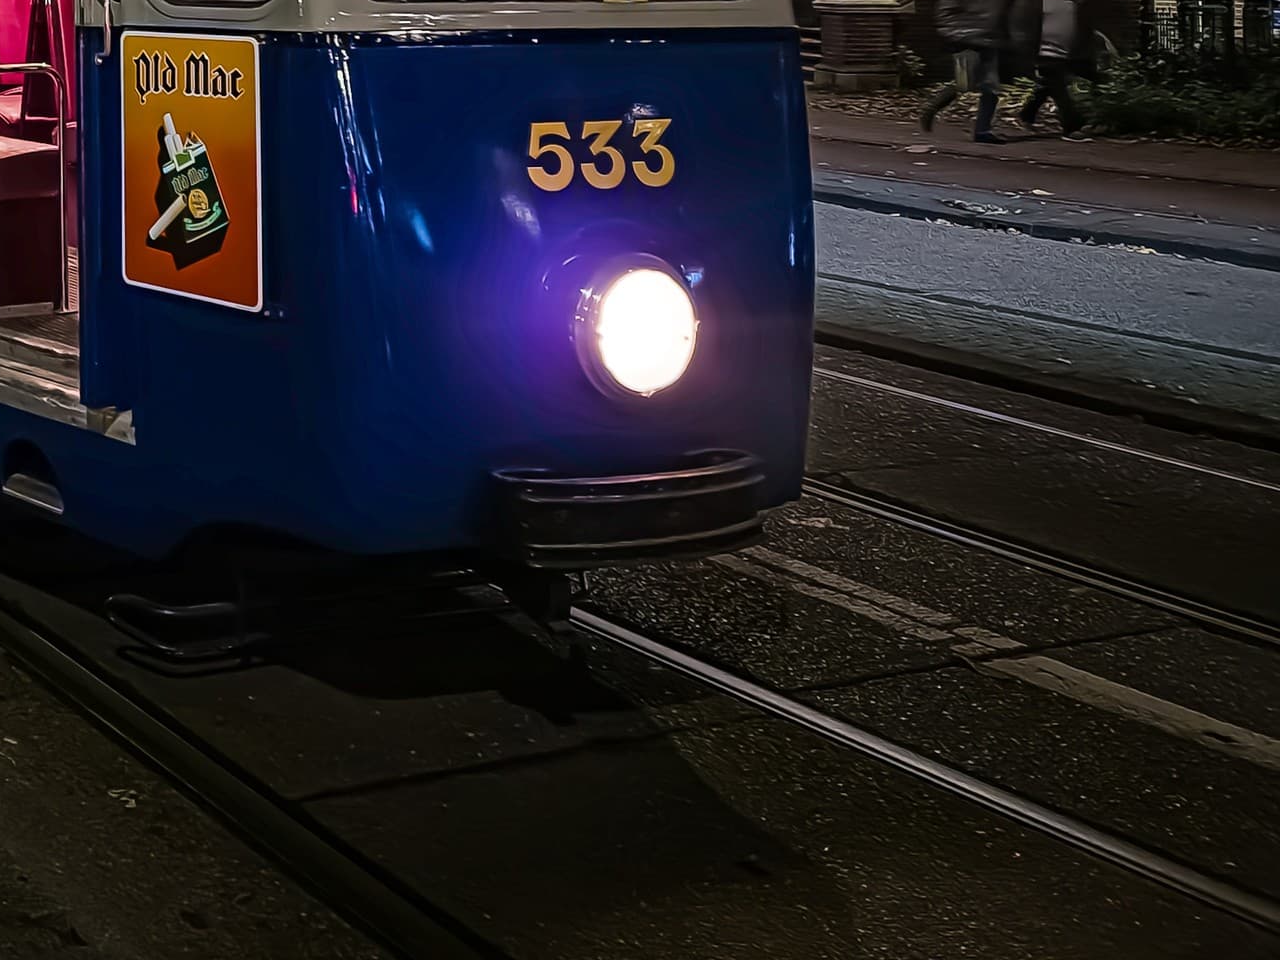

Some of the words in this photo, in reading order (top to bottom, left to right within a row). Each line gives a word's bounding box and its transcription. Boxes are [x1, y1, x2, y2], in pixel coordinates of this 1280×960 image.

[132, 49, 178, 105] Old
[183, 49, 246, 100] Mac
[527, 118, 676, 192] 533
